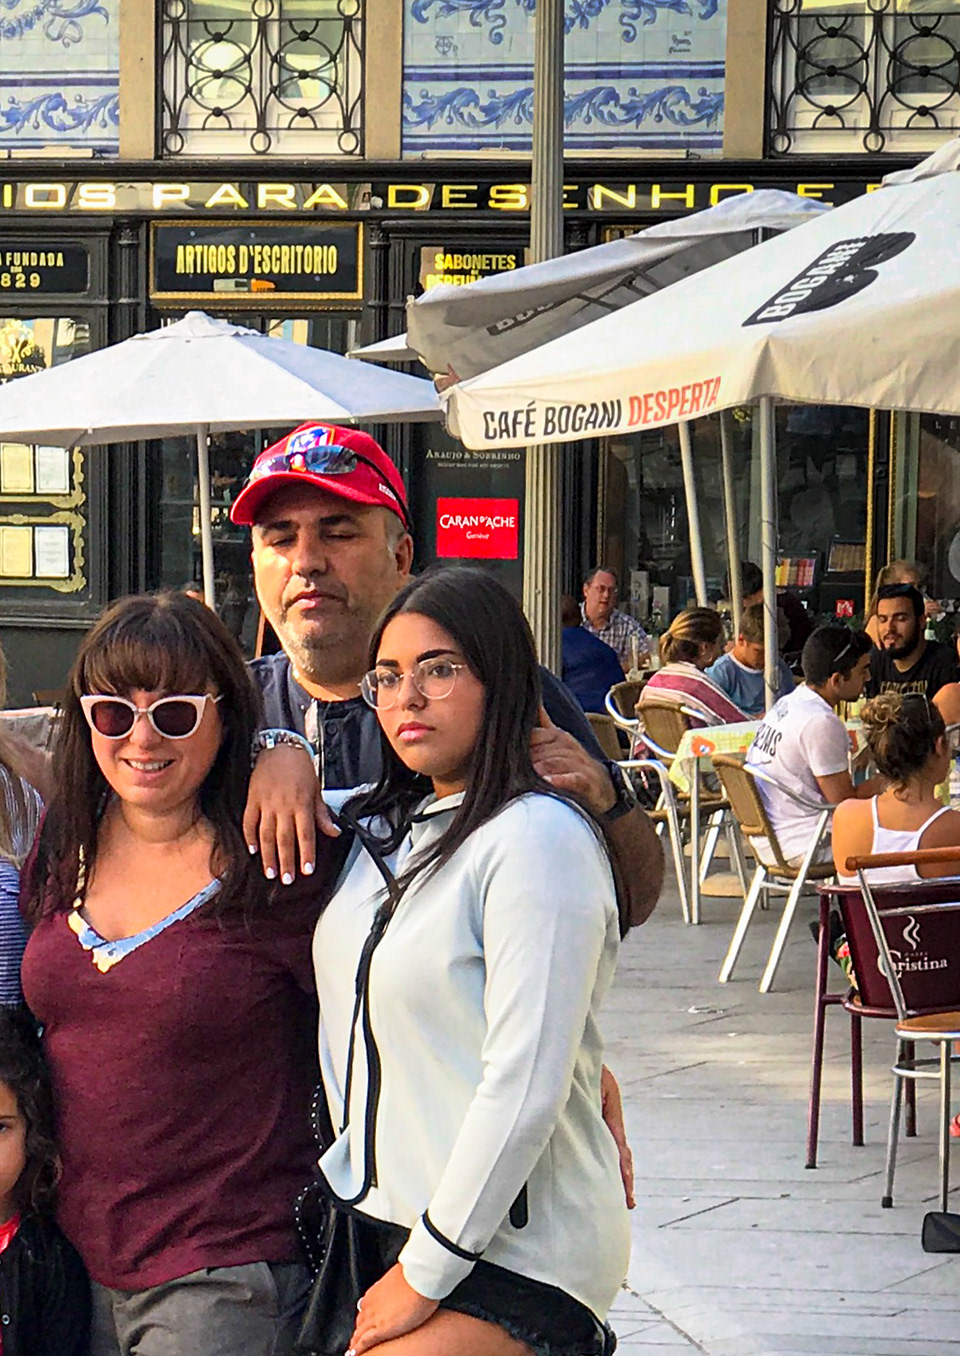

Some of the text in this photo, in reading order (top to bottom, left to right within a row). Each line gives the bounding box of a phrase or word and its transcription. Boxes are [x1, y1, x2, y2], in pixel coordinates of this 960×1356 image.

[152, 183, 348, 209] PARA
[5, 251, 64, 267] FUNDADA
[176, 245, 337, 274] ARTIGOS D'ESCRITORIO
[434, 253, 516, 270] SABONETES
[483, 376, 722, 440] CAFÉ BOGANI DESPERTA
[472, 450, 521, 460] SOBRINHO
[439, 514, 479, 529] CARAN
